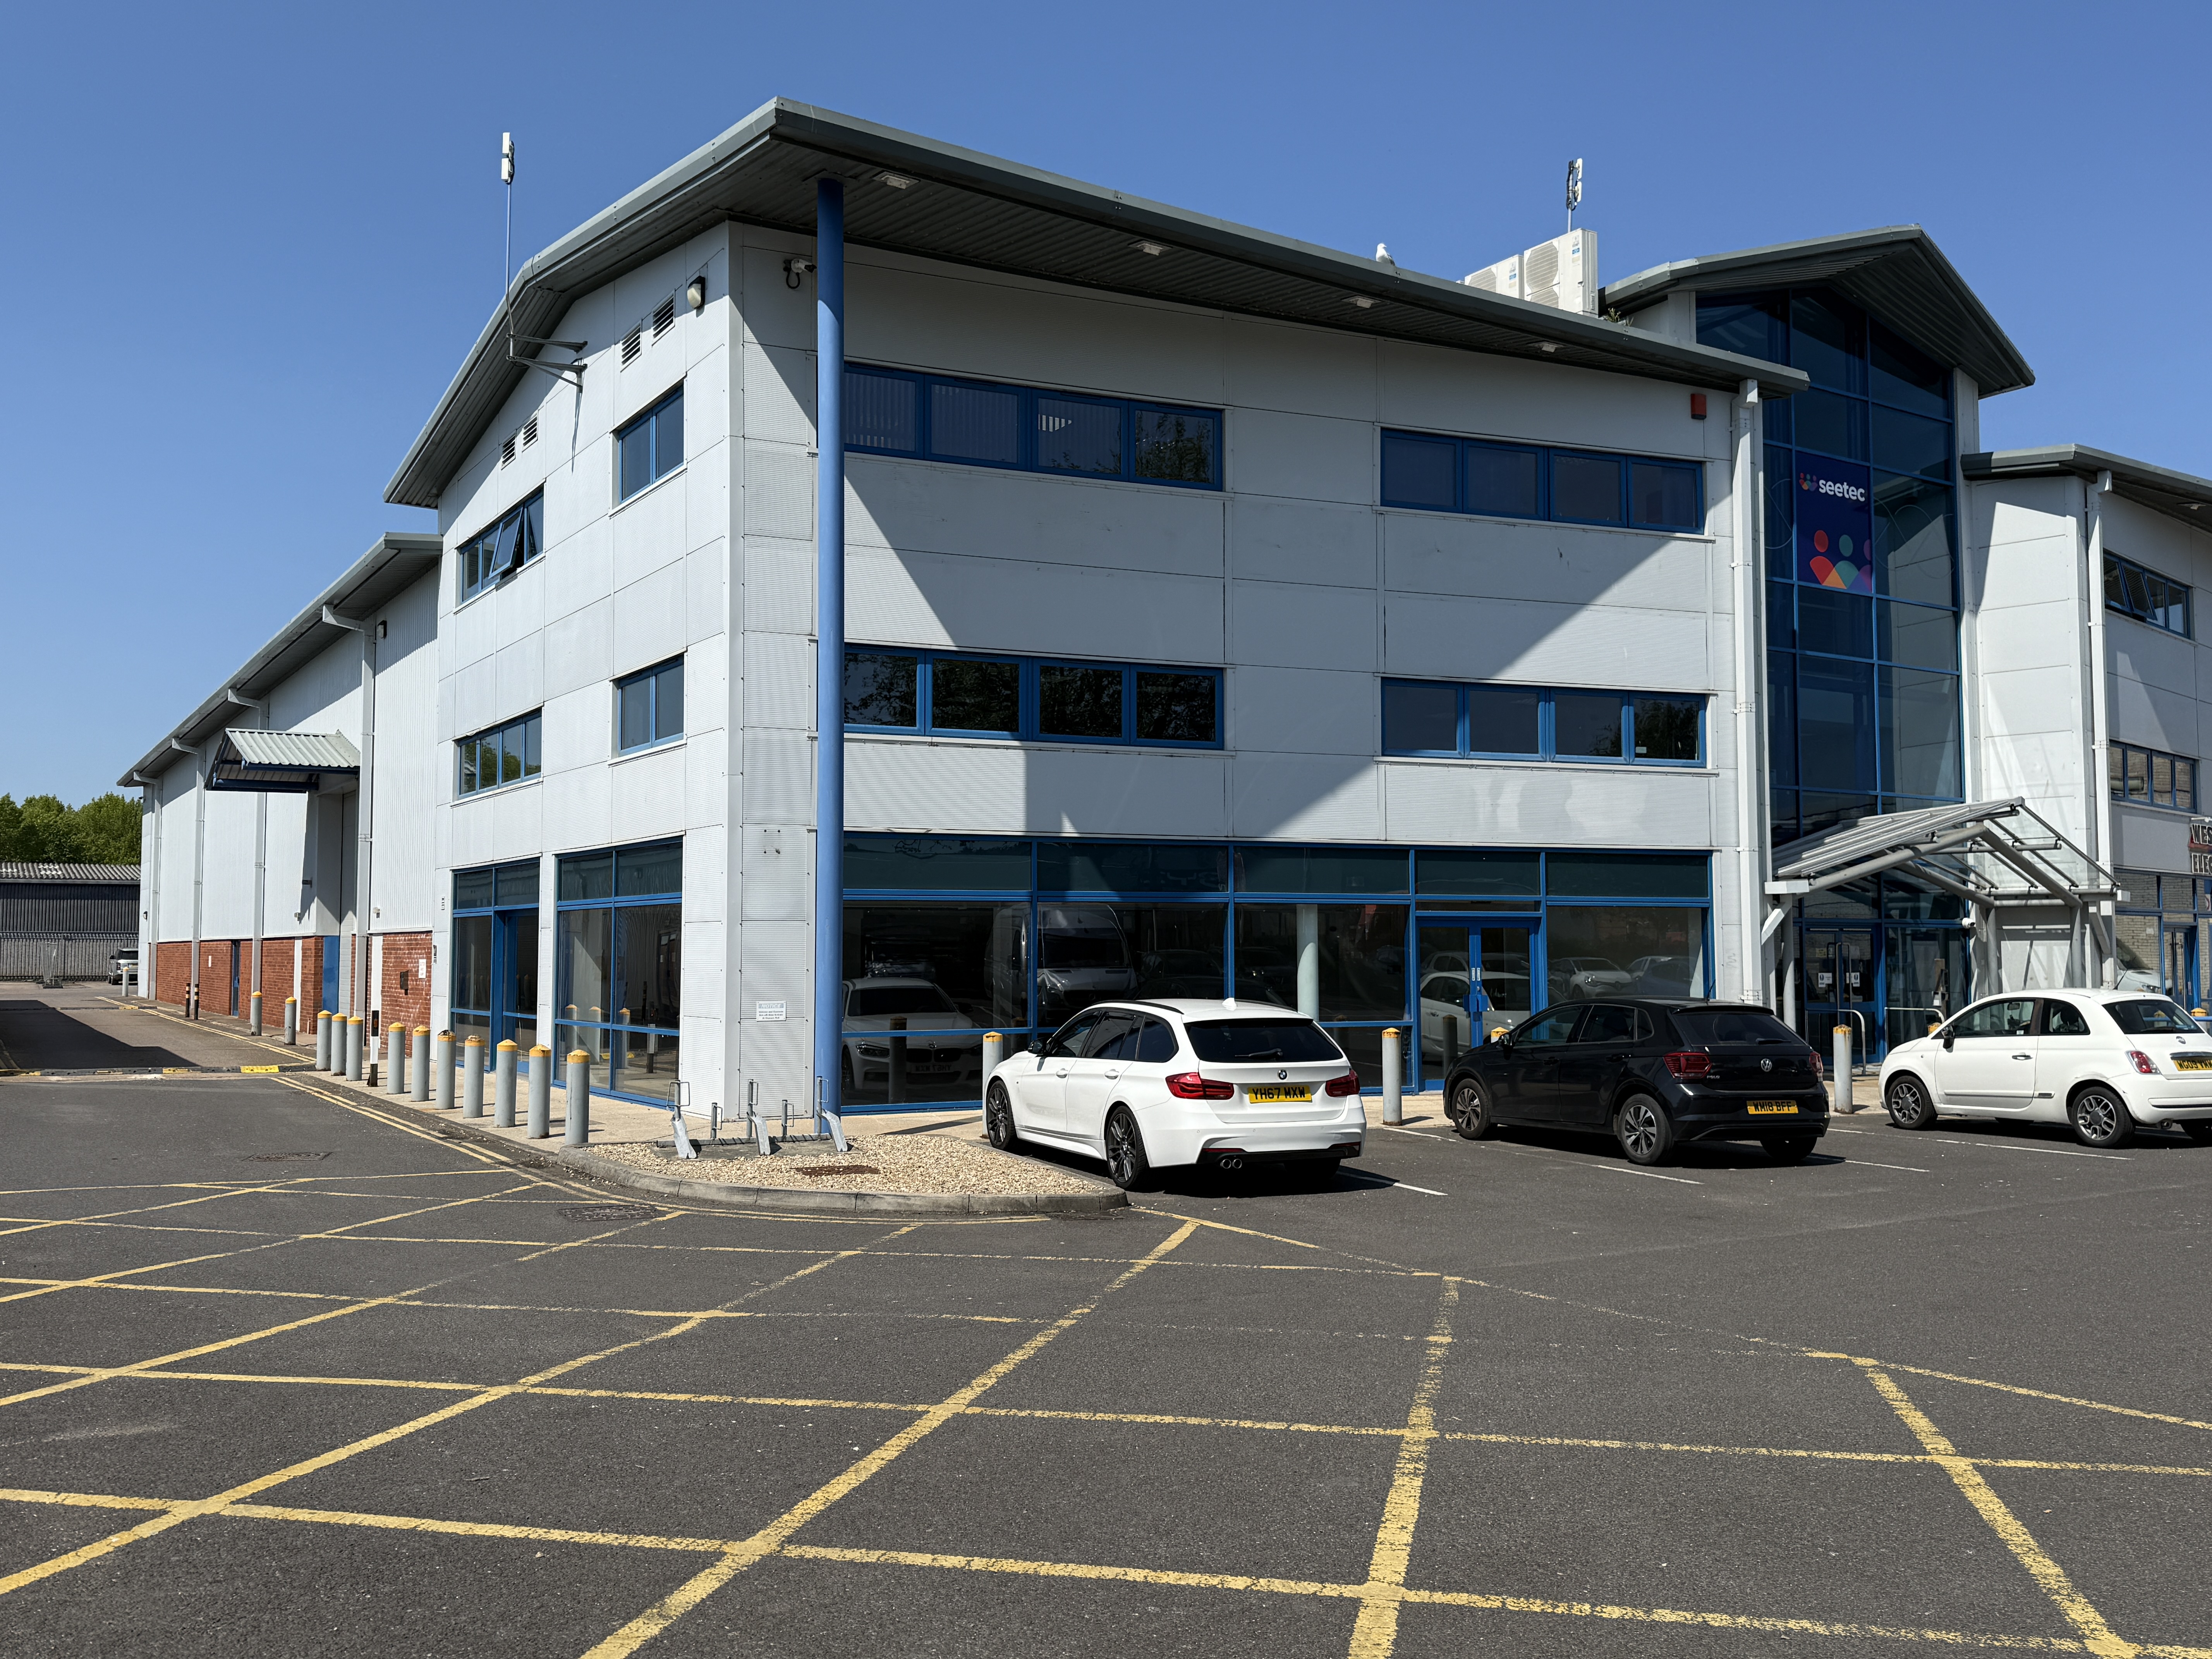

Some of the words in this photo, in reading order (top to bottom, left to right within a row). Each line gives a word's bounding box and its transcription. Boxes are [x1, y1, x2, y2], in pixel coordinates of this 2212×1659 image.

[1819, 479, 1865, 501] seetec
[1252, 1087, 1281, 1100] YH67
[1284, 1087, 1305, 1099] MXW
[1753, 1101, 1774, 1112] WM18
[1775, 1101, 1791, 1111] BFF
